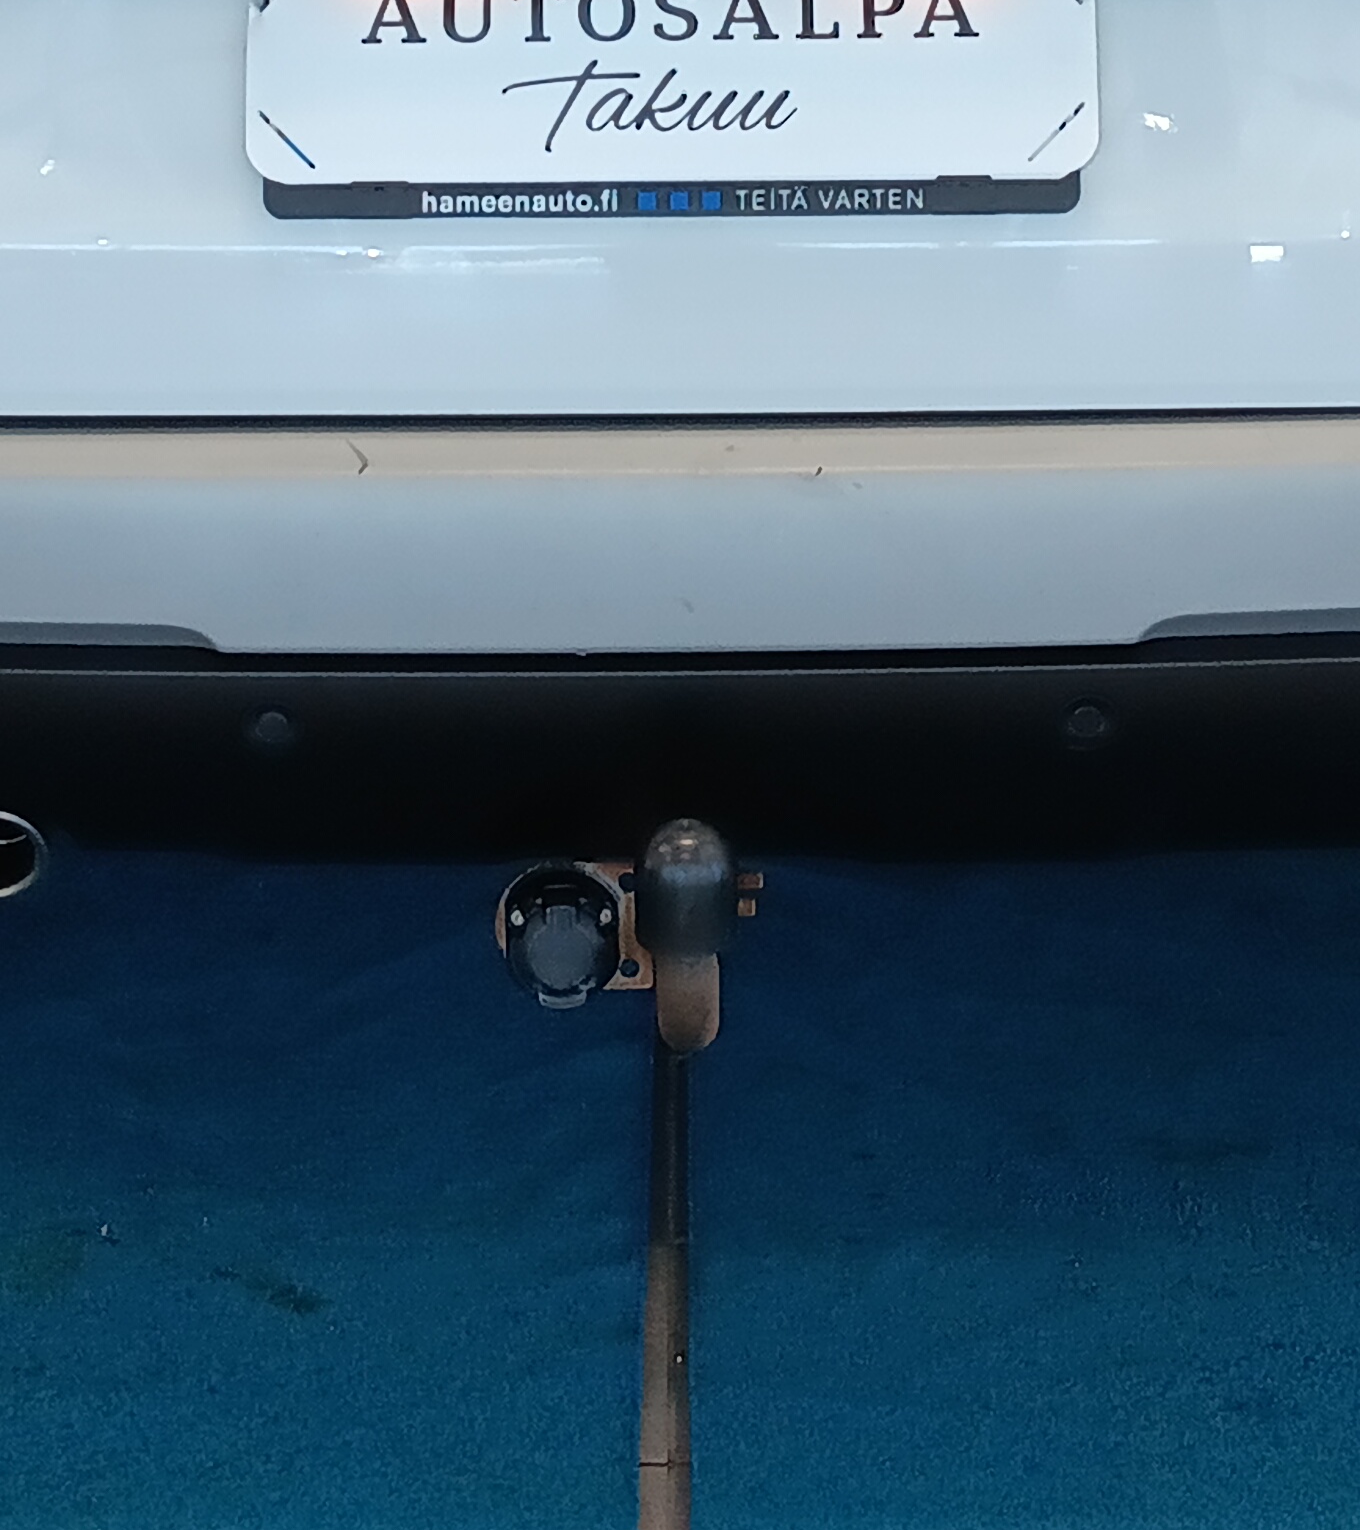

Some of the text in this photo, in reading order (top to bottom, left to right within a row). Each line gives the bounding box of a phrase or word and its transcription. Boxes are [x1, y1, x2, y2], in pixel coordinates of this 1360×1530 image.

[501, 59, 799, 153] Takuu
[421, 185, 924, 214] hameenauto.fi TEITÄ VARTEN
